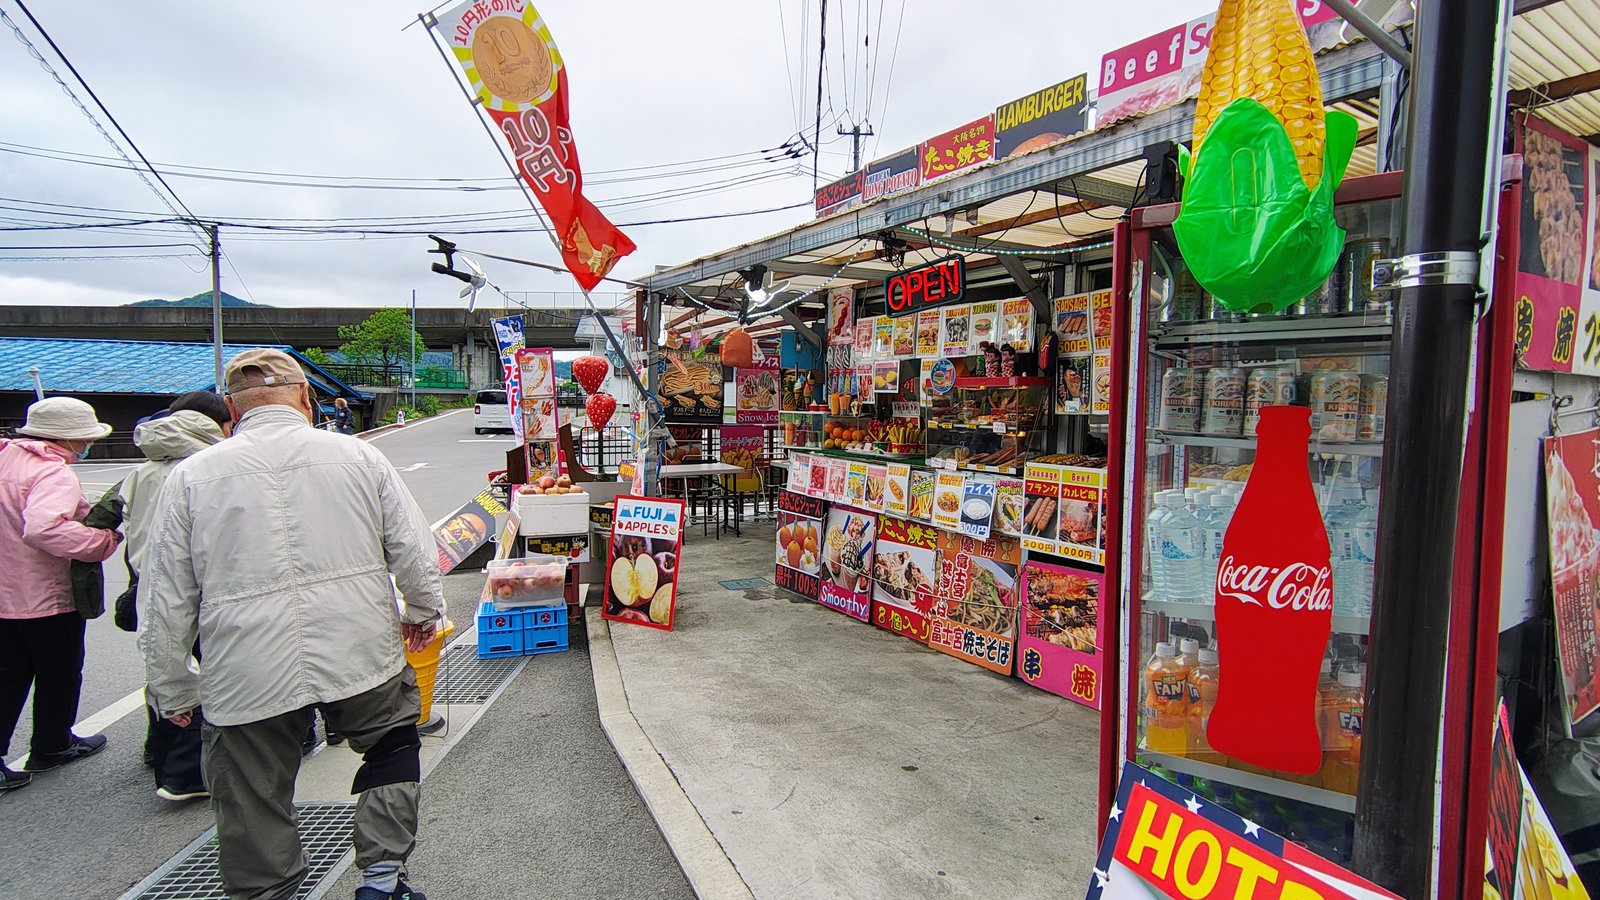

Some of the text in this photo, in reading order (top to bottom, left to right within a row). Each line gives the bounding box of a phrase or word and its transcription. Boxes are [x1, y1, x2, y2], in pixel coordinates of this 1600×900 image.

[1103, 32, 1182, 89] Beef
[996, 76, 1084, 133] HAMBURGER
[952, 125, 985, 145] 大阪名物
[924, 140, 991, 175] たこ焼き
[816, 175, 862, 208] まるごとジュース
[864, 168, 917, 200] LONG POTATO
[888, 260, 960, 311] OPEN
[1056, 296, 1088, 312] SAUSAGE
[1058, 339, 1089, 353] 500円
[1211, 399, 1232, 407] KIRIN
[738, 413, 764, 422] Snow
[965, 480, 995, 496] ライス
[1027, 469, 1091, 482] Sausage Beef
[779, 492, 821, 516] まるごとジュース
[1027, 482, 1059, 495] フランク
[1062, 487, 1097, 500] カルビ串
[633, 506, 663, 521] FUJI
[624, 521, 669, 535] APPLES
[877, 514, 938, 549] たこ焼き
[1023, 540, 1053, 553] 500円
[1058, 545, 1092, 560] 1000円
[776, 568, 818, 596] 果汁 100%
[952, 553, 970, 600] 富士宮
[1218, 555, 1331, 611] Coca-Cola
[821, 585, 867, 616] Smoothy
[931, 620, 1011, 666] 富士宮焼きそば
[1338, 711, 1363, 729] FA
[1127, 800, 1326, 900] HOT
